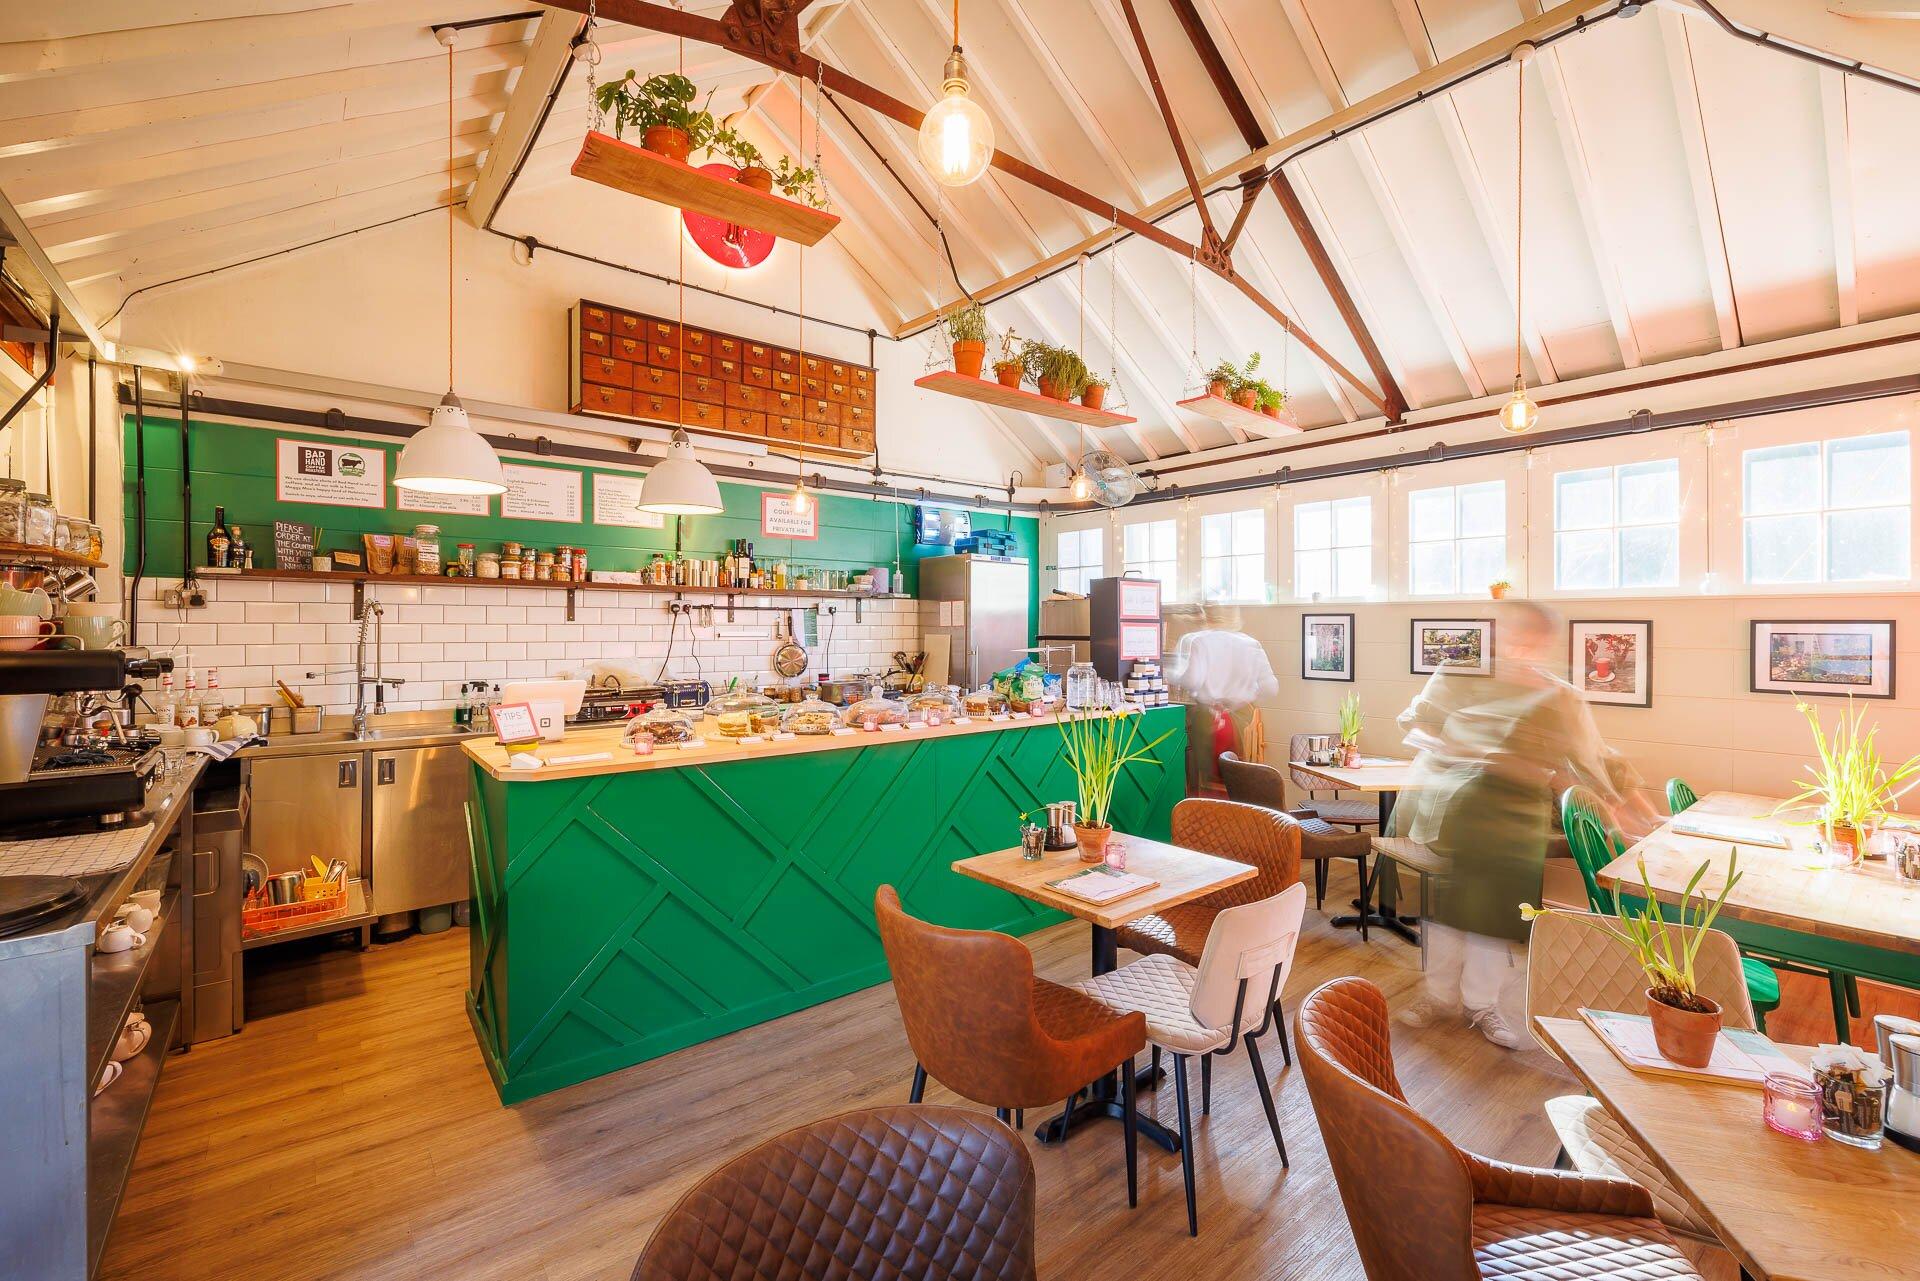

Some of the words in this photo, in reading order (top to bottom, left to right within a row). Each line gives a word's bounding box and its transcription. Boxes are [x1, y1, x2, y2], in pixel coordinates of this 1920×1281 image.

[305, 449, 325, 458] BAD
[305, 458, 326, 466] HAND
[275, 521, 304, 535] PLEASE
[772, 525, 795, 533] PRIVATE
[275, 531, 300, 542] ORDER
[275, 539, 291, 548] THE
[277, 547, 294, 556] WITH
[295, 549, 312, 558] YOUR
[277, 555, 301, 564] TABLE
[284, 562, 312, 571] NUMBER
[504, 711, 521, 720] TIPS
